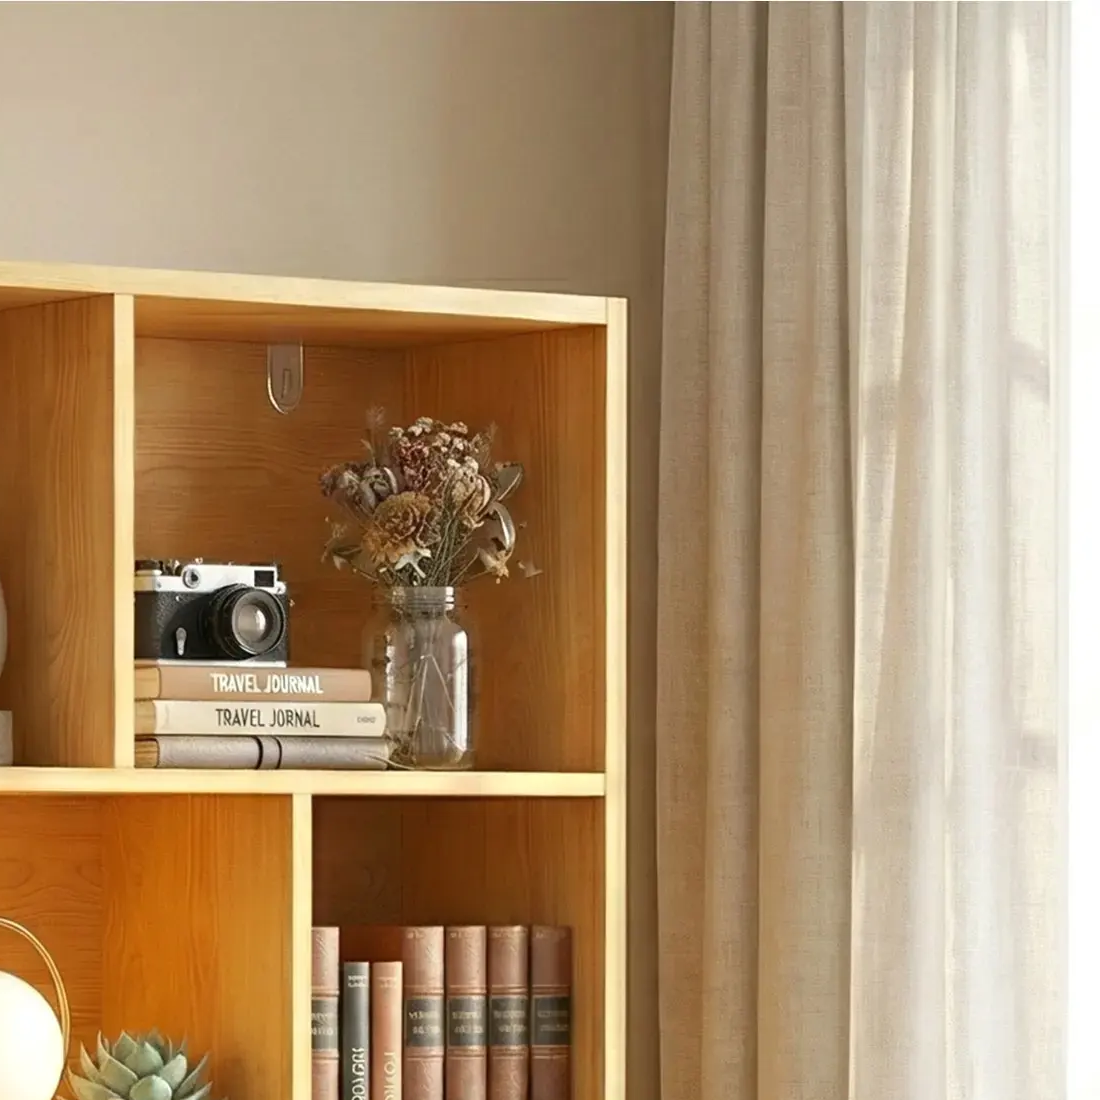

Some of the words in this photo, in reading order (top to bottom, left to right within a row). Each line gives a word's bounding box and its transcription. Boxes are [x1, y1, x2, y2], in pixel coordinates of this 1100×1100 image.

[210, 673, 261, 693] TRAVEL
[263, 674, 324, 694] JOURNAL
[215, 708, 265, 727] TRAVEL
[269, 708, 320, 728] JORNAL
